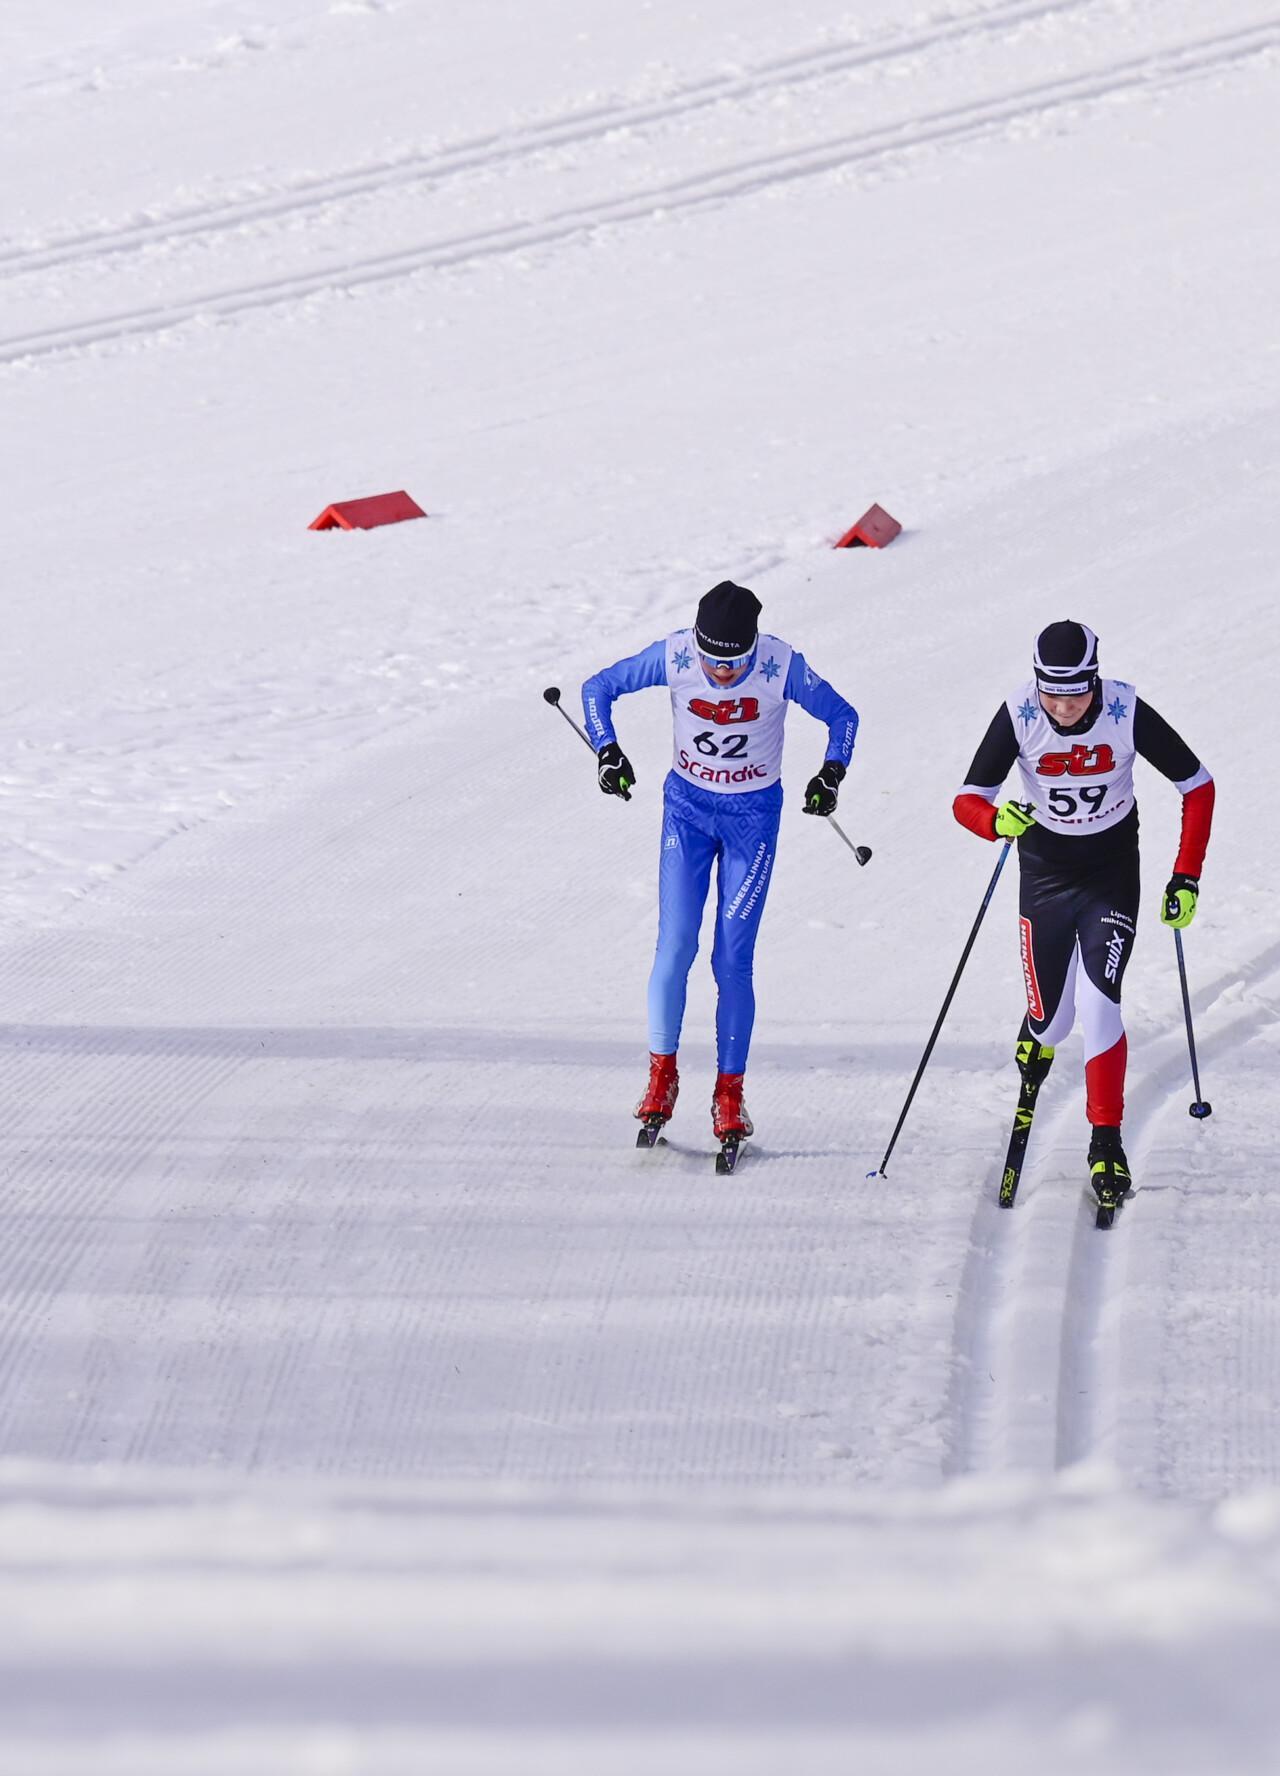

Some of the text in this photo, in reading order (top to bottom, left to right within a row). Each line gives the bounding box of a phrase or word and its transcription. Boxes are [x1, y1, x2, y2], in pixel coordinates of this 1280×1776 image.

[693, 731, 749, 759] 62
[678, 749, 767, 784] Scandic
[1048, 784, 1108, 817] 59
[739, 854, 772, 920] HIIHTOSEURA
